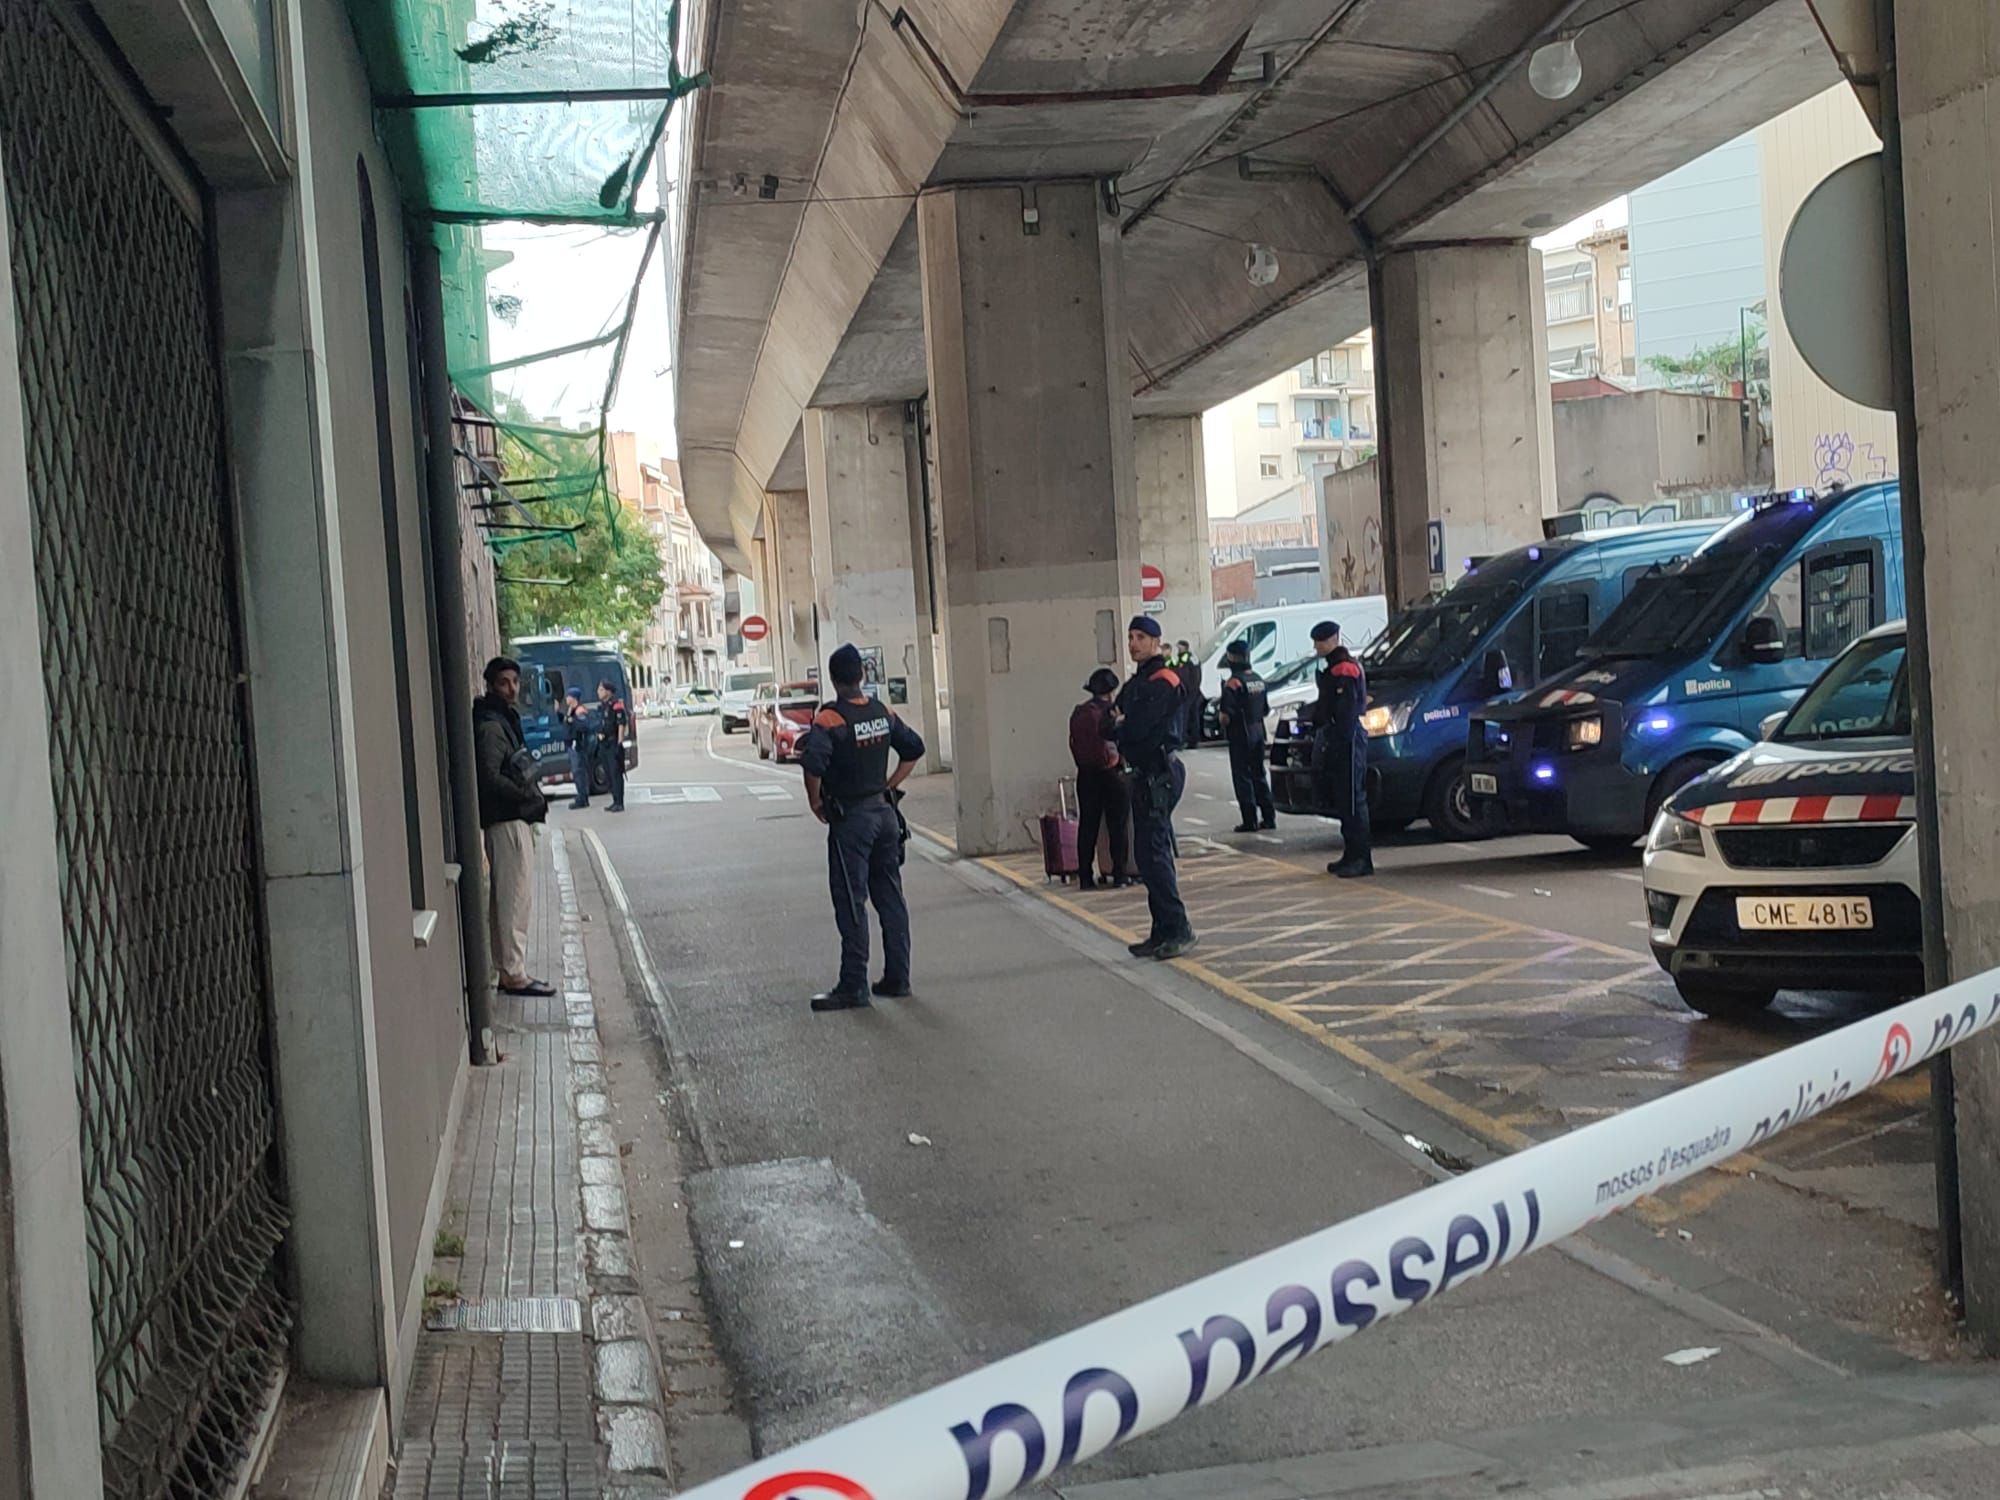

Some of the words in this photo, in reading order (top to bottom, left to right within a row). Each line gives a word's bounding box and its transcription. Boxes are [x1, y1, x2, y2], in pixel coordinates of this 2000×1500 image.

[1429, 525, 1440, 571] P
[854, 717, 889, 736] POLICIA
[1754, 903, 1798, 925] CME
[1808, 903, 1869, 925] 4815
[1595, 1160, 1654, 1204] mossos
[1657, 1125, 1731, 1177] d'esquadra
